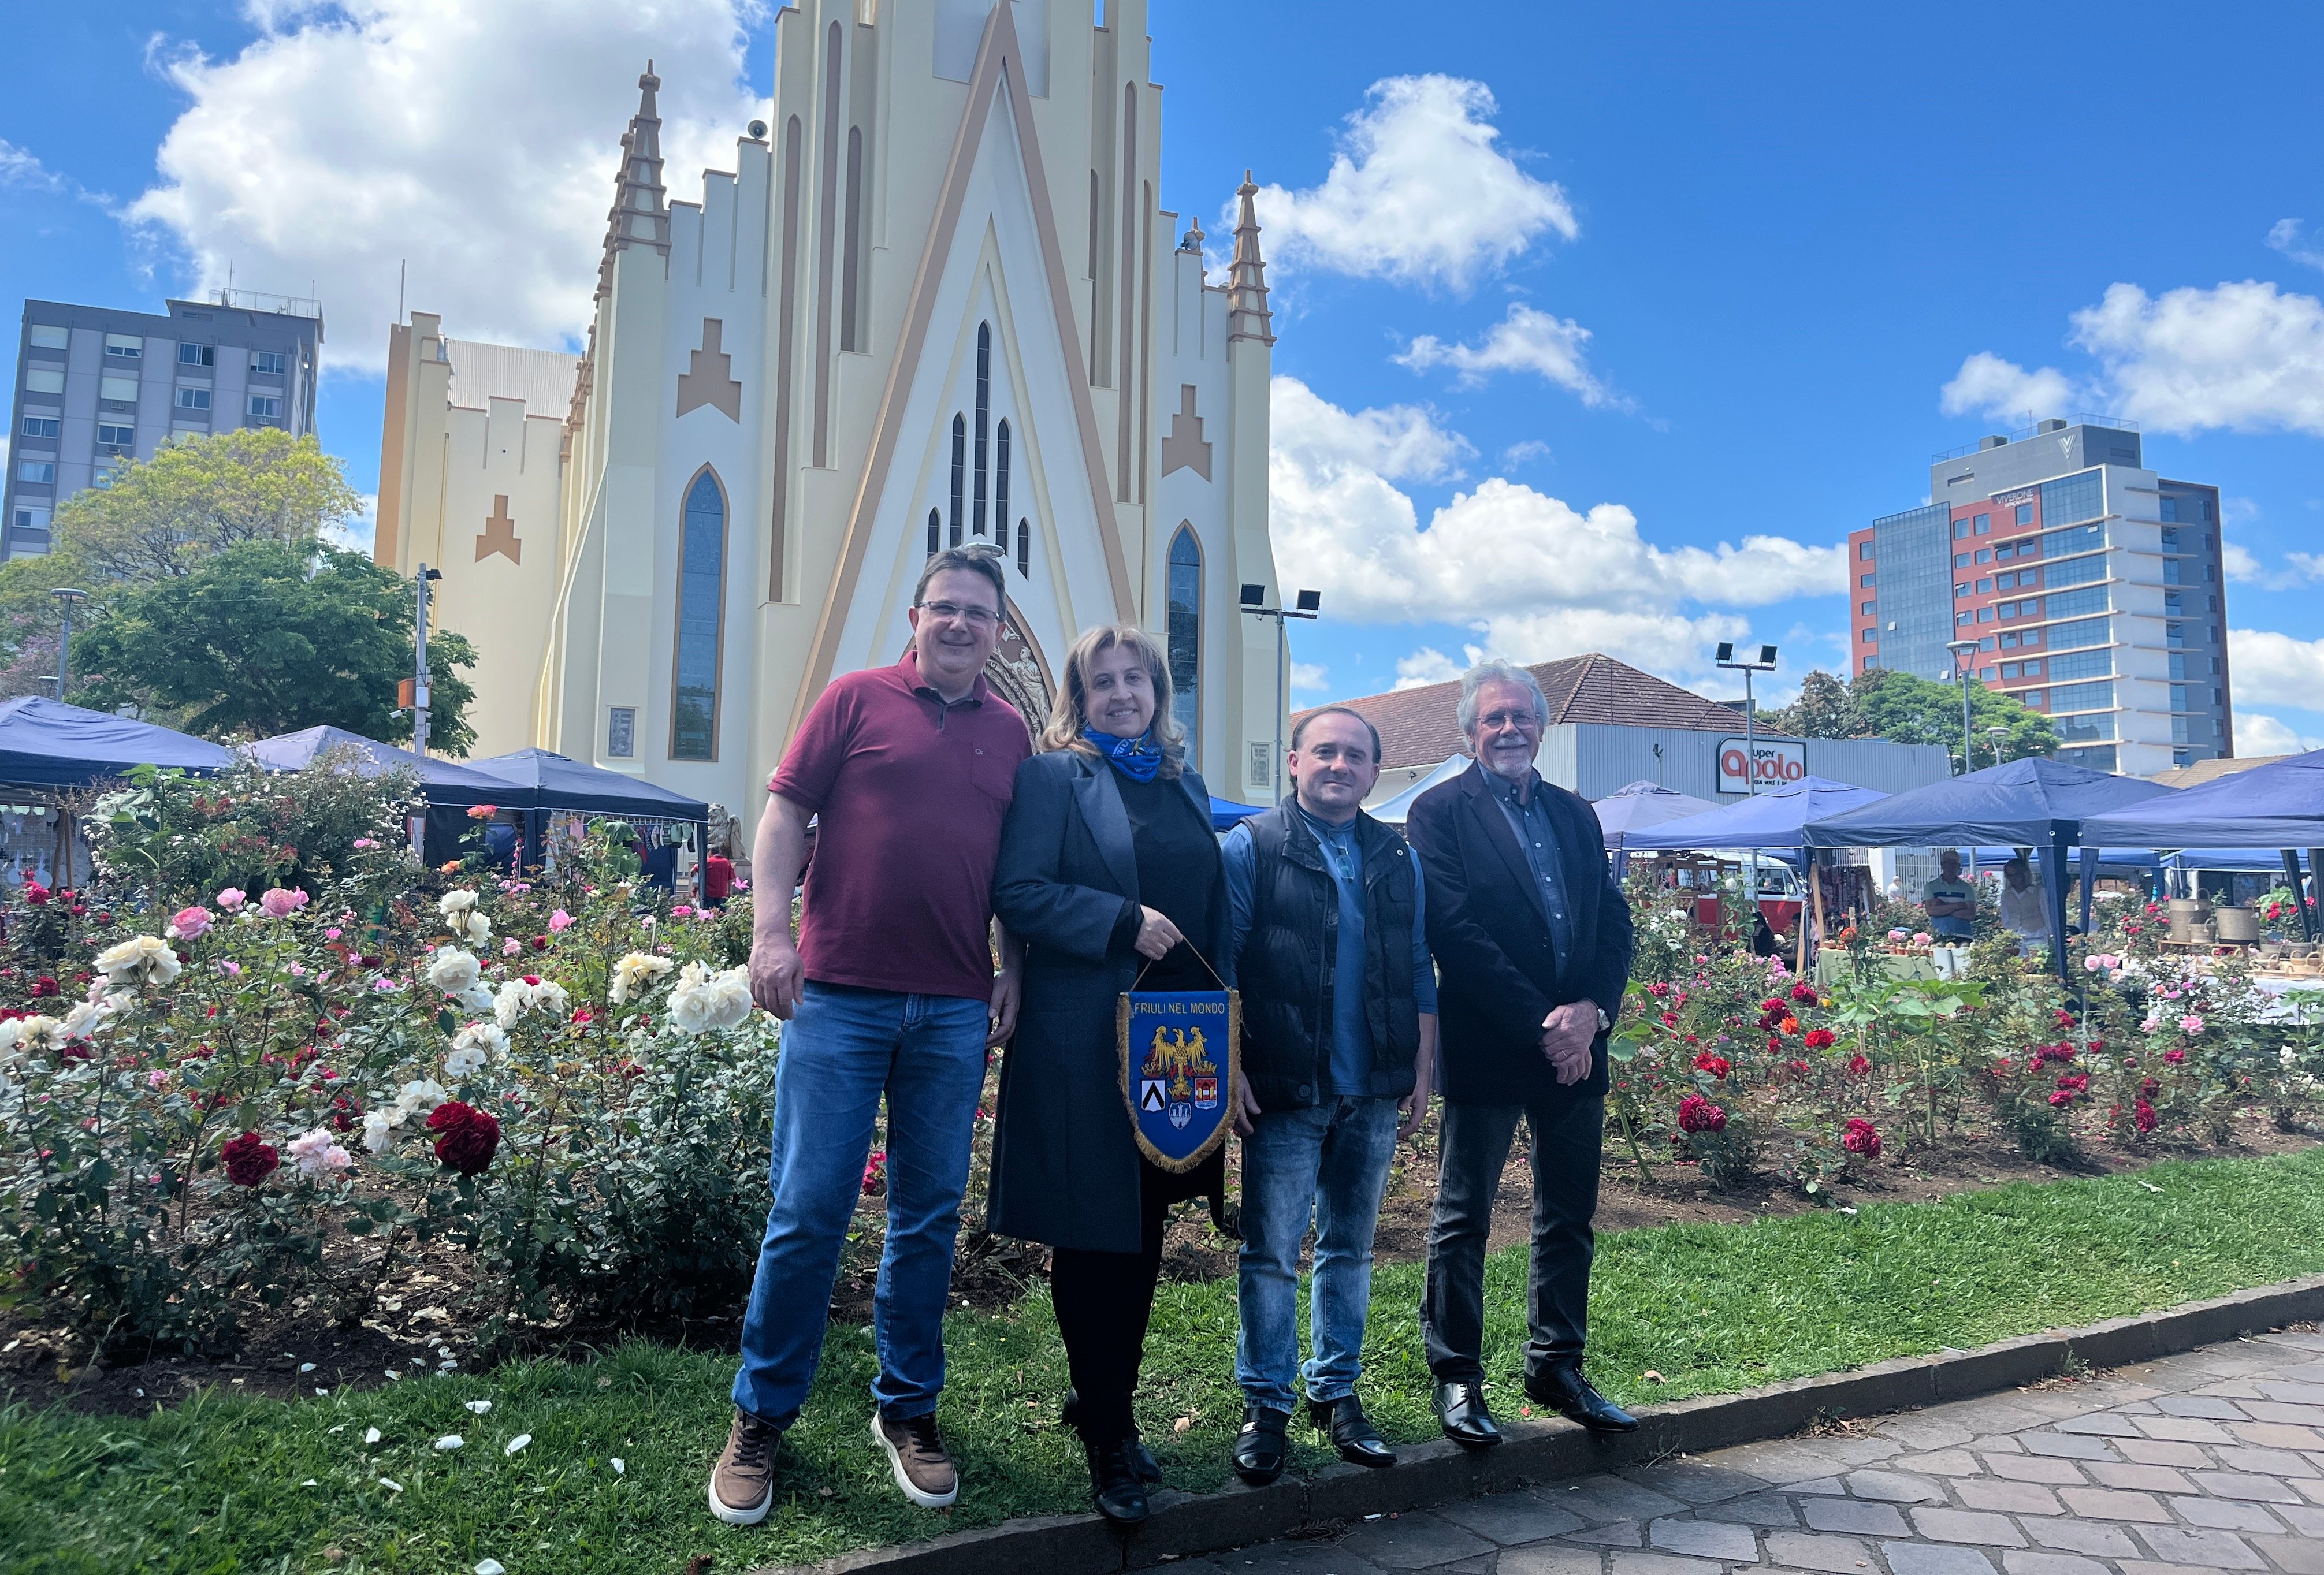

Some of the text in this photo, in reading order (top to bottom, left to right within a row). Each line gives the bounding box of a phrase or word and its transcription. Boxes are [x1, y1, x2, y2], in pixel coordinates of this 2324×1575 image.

[1996, 488, 2033, 504] VIVERONE
[1747, 749, 1776, 759] uper
[1135, 1003, 1225, 1014] FRIULI NEL MONDO
